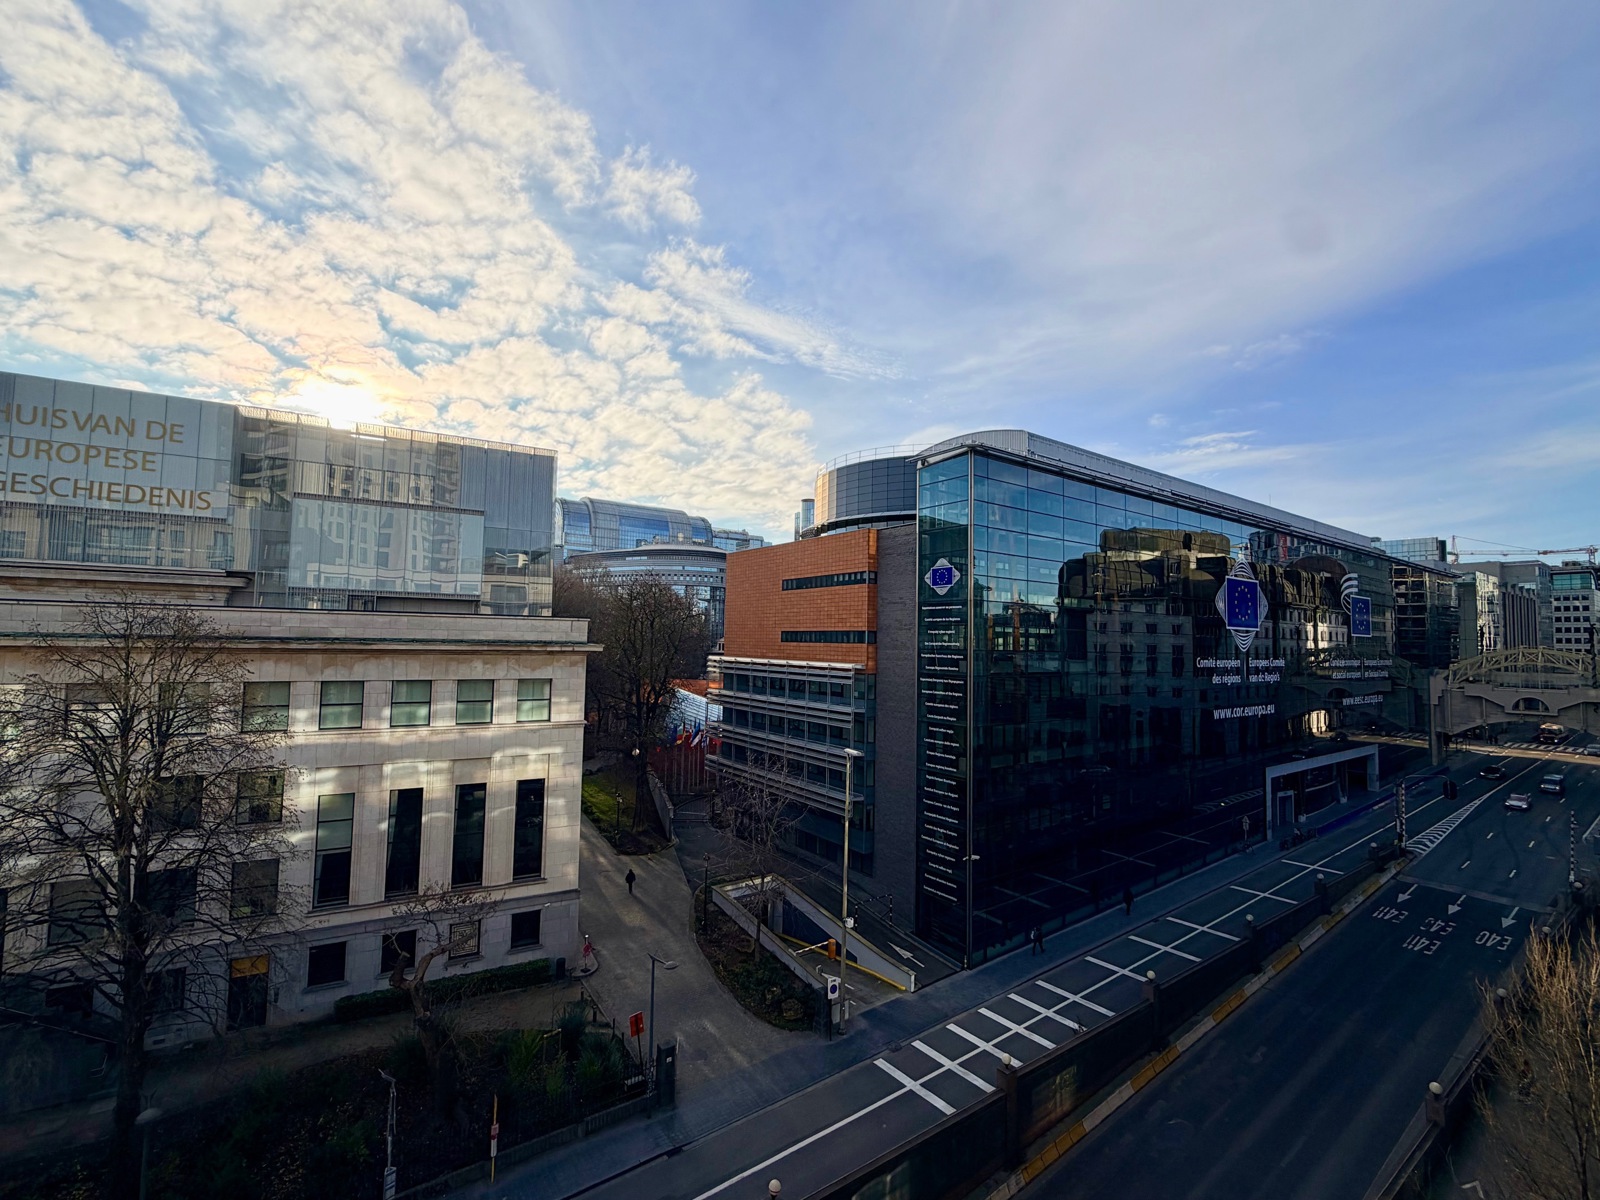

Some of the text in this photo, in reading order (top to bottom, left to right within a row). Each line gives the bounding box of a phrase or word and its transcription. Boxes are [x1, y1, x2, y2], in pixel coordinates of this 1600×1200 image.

[146, 421, 184, 444] DE
[0, 435, 157, 472] UROPESE
[1196, 657, 1241, 669] Comité européen
[1249, 657, 1269, 669] Europees
[1212, 673, 1241, 685] des régions
[1248, 672, 1280, 684] van de Regio's
[1213, 704, 1275, 720] www.cor.europa.eu
[1475, 930, 1513, 951] E40
